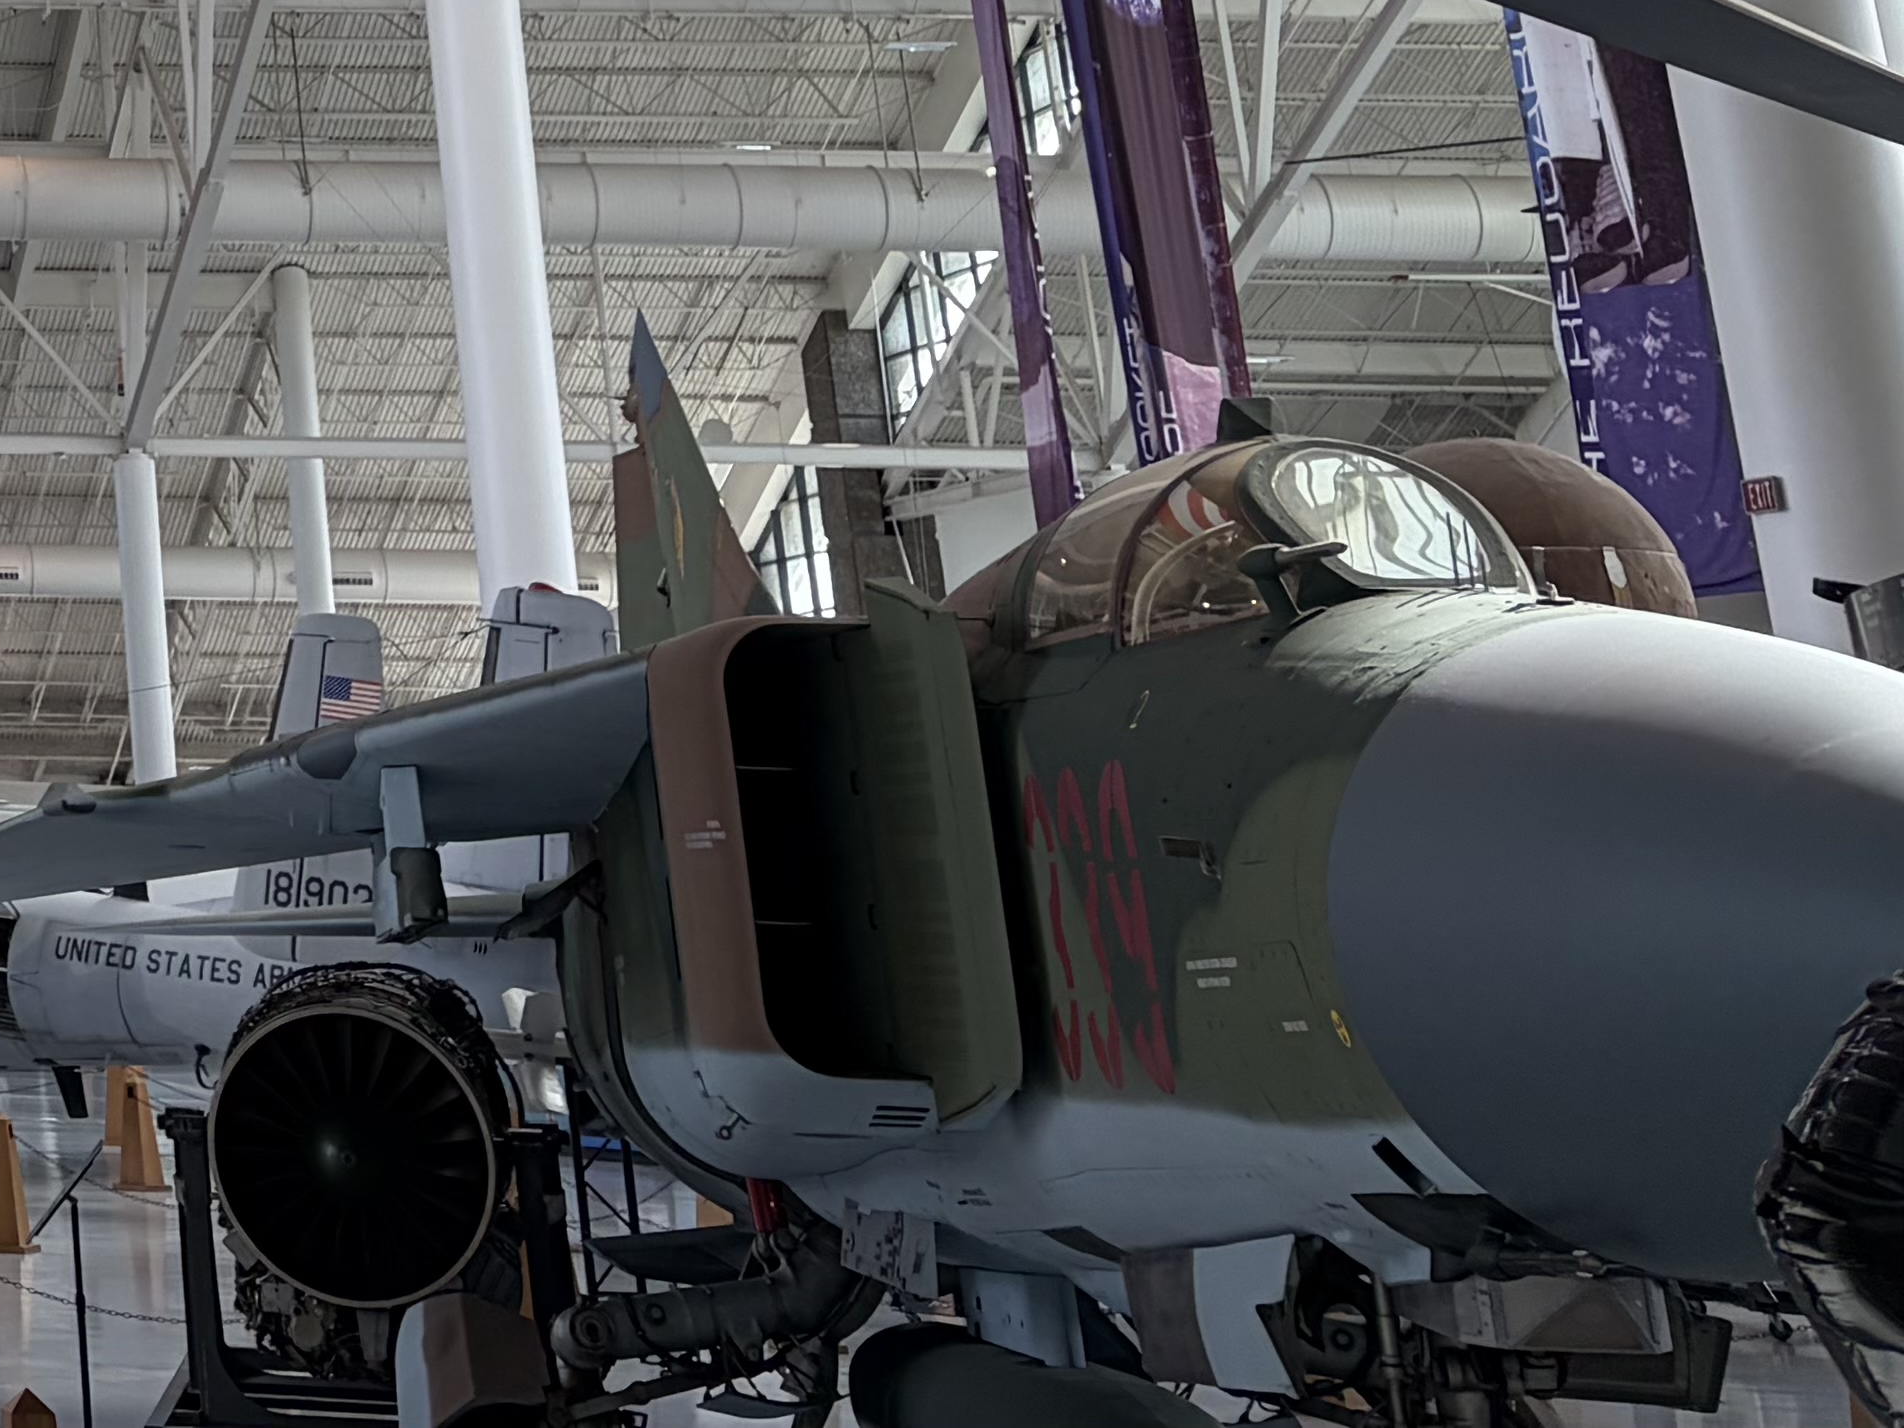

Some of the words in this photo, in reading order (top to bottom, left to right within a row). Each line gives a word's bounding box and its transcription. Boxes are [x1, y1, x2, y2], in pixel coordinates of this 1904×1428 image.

[1747, 481, 1774, 510] EXIT
[54, 934, 137, 970] UNITED
[146, 948, 242, 985] STATES
